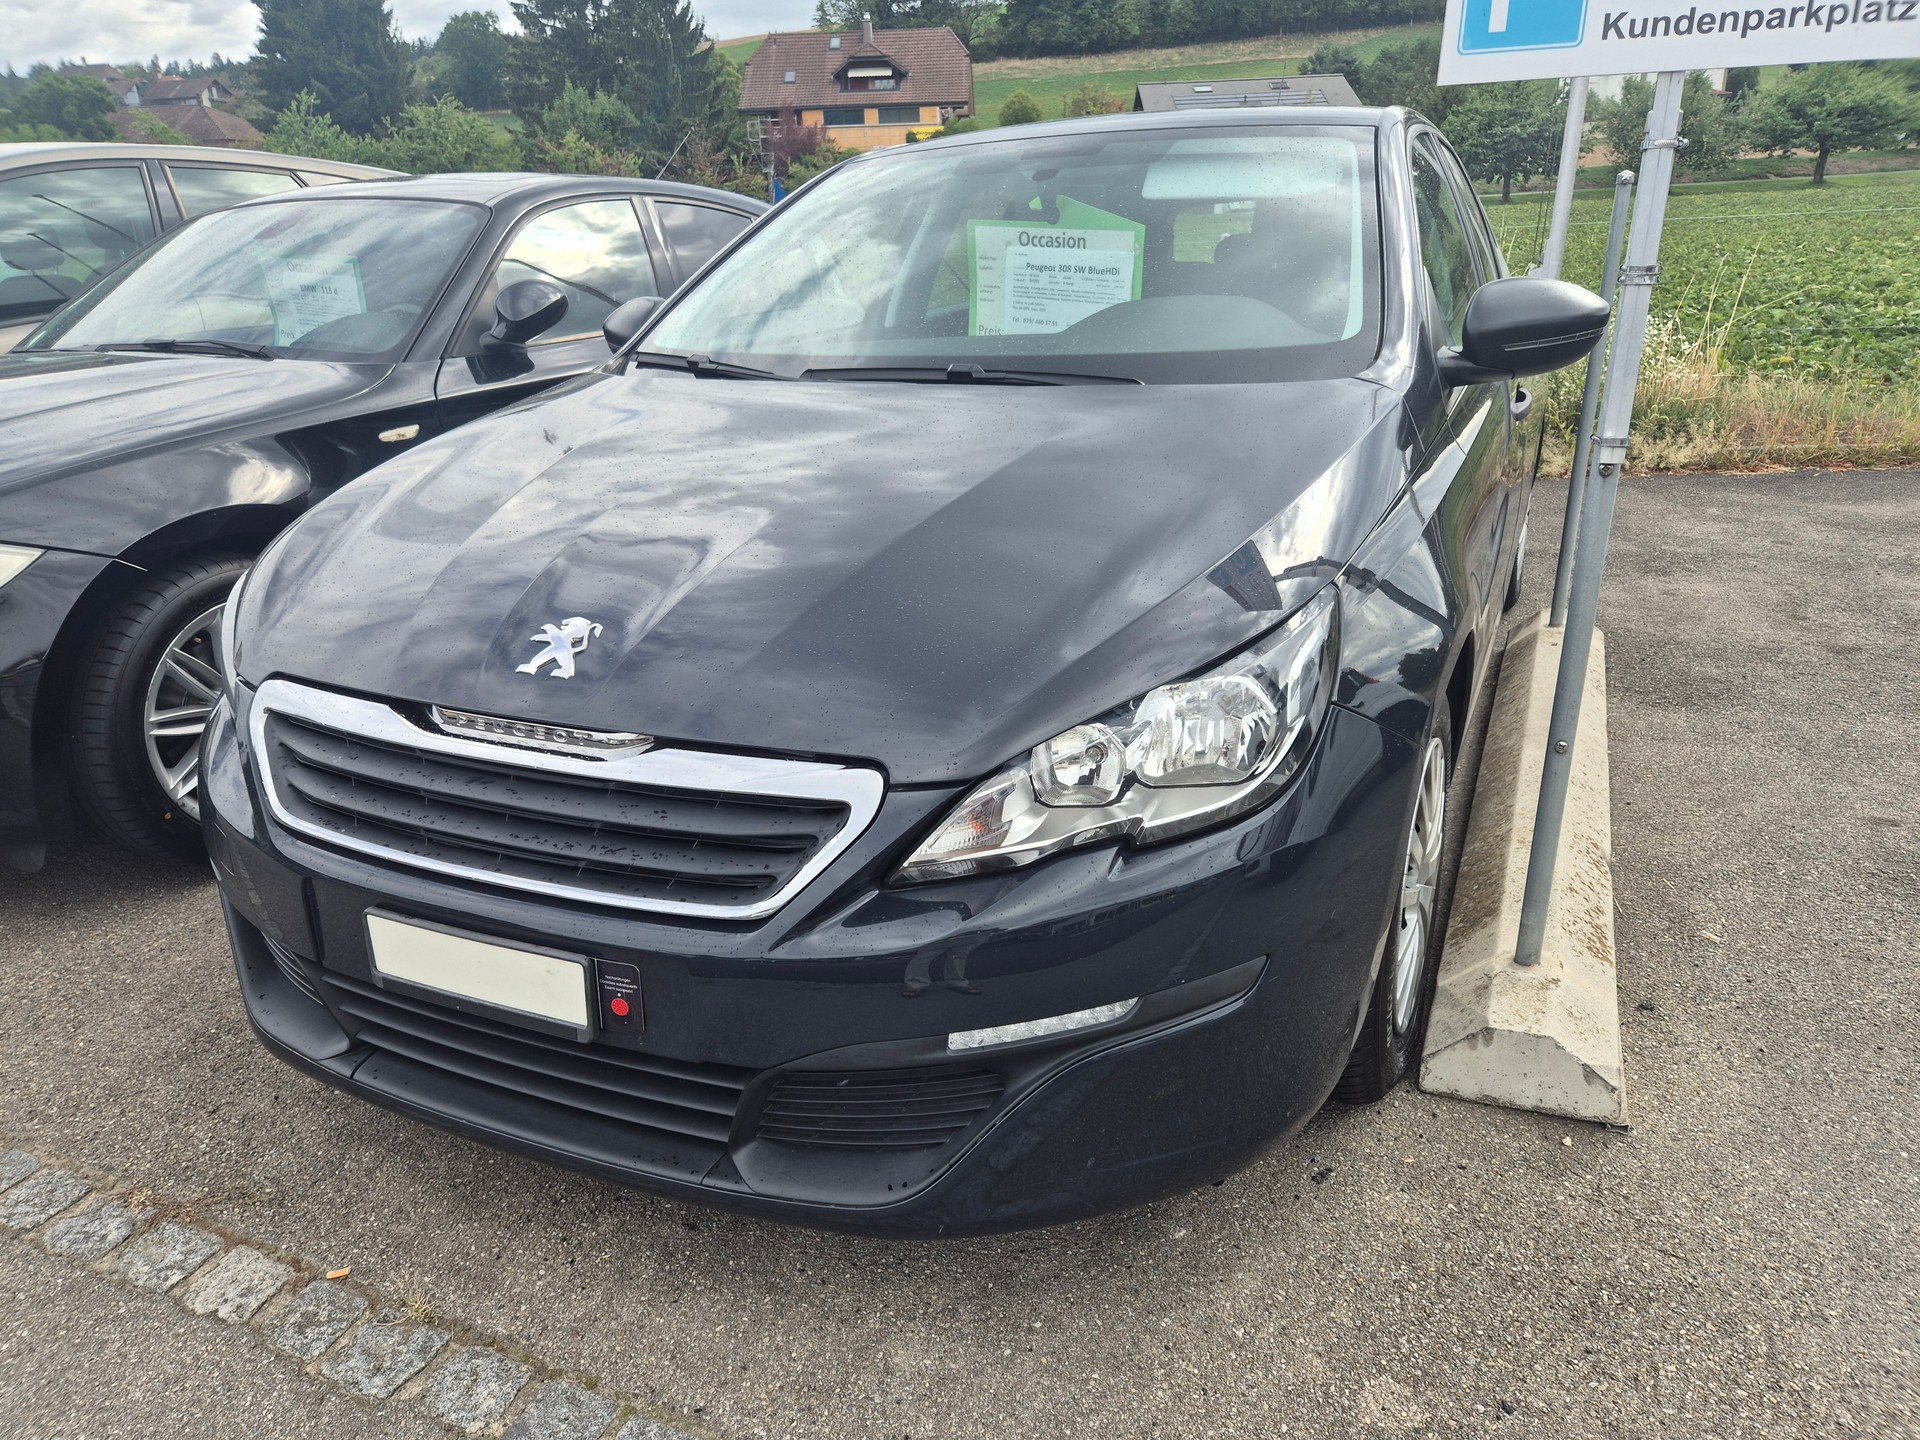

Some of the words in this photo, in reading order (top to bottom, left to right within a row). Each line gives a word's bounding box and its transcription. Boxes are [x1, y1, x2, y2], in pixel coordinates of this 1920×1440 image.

[1601, 0, 1919, 41] Kundenparkplatz
[1018, 231, 1087, 249] Occasion
[1025, 262, 1056, 274] Peugeot
[1058, 264, 1072, 273] 308
[1073, 265, 1086, 274] SW
[1088, 266, 1120, 276] BlueHDi
[300, 284, 317, 293] BMW
[455, 716, 592, 745] PEUGEOT
